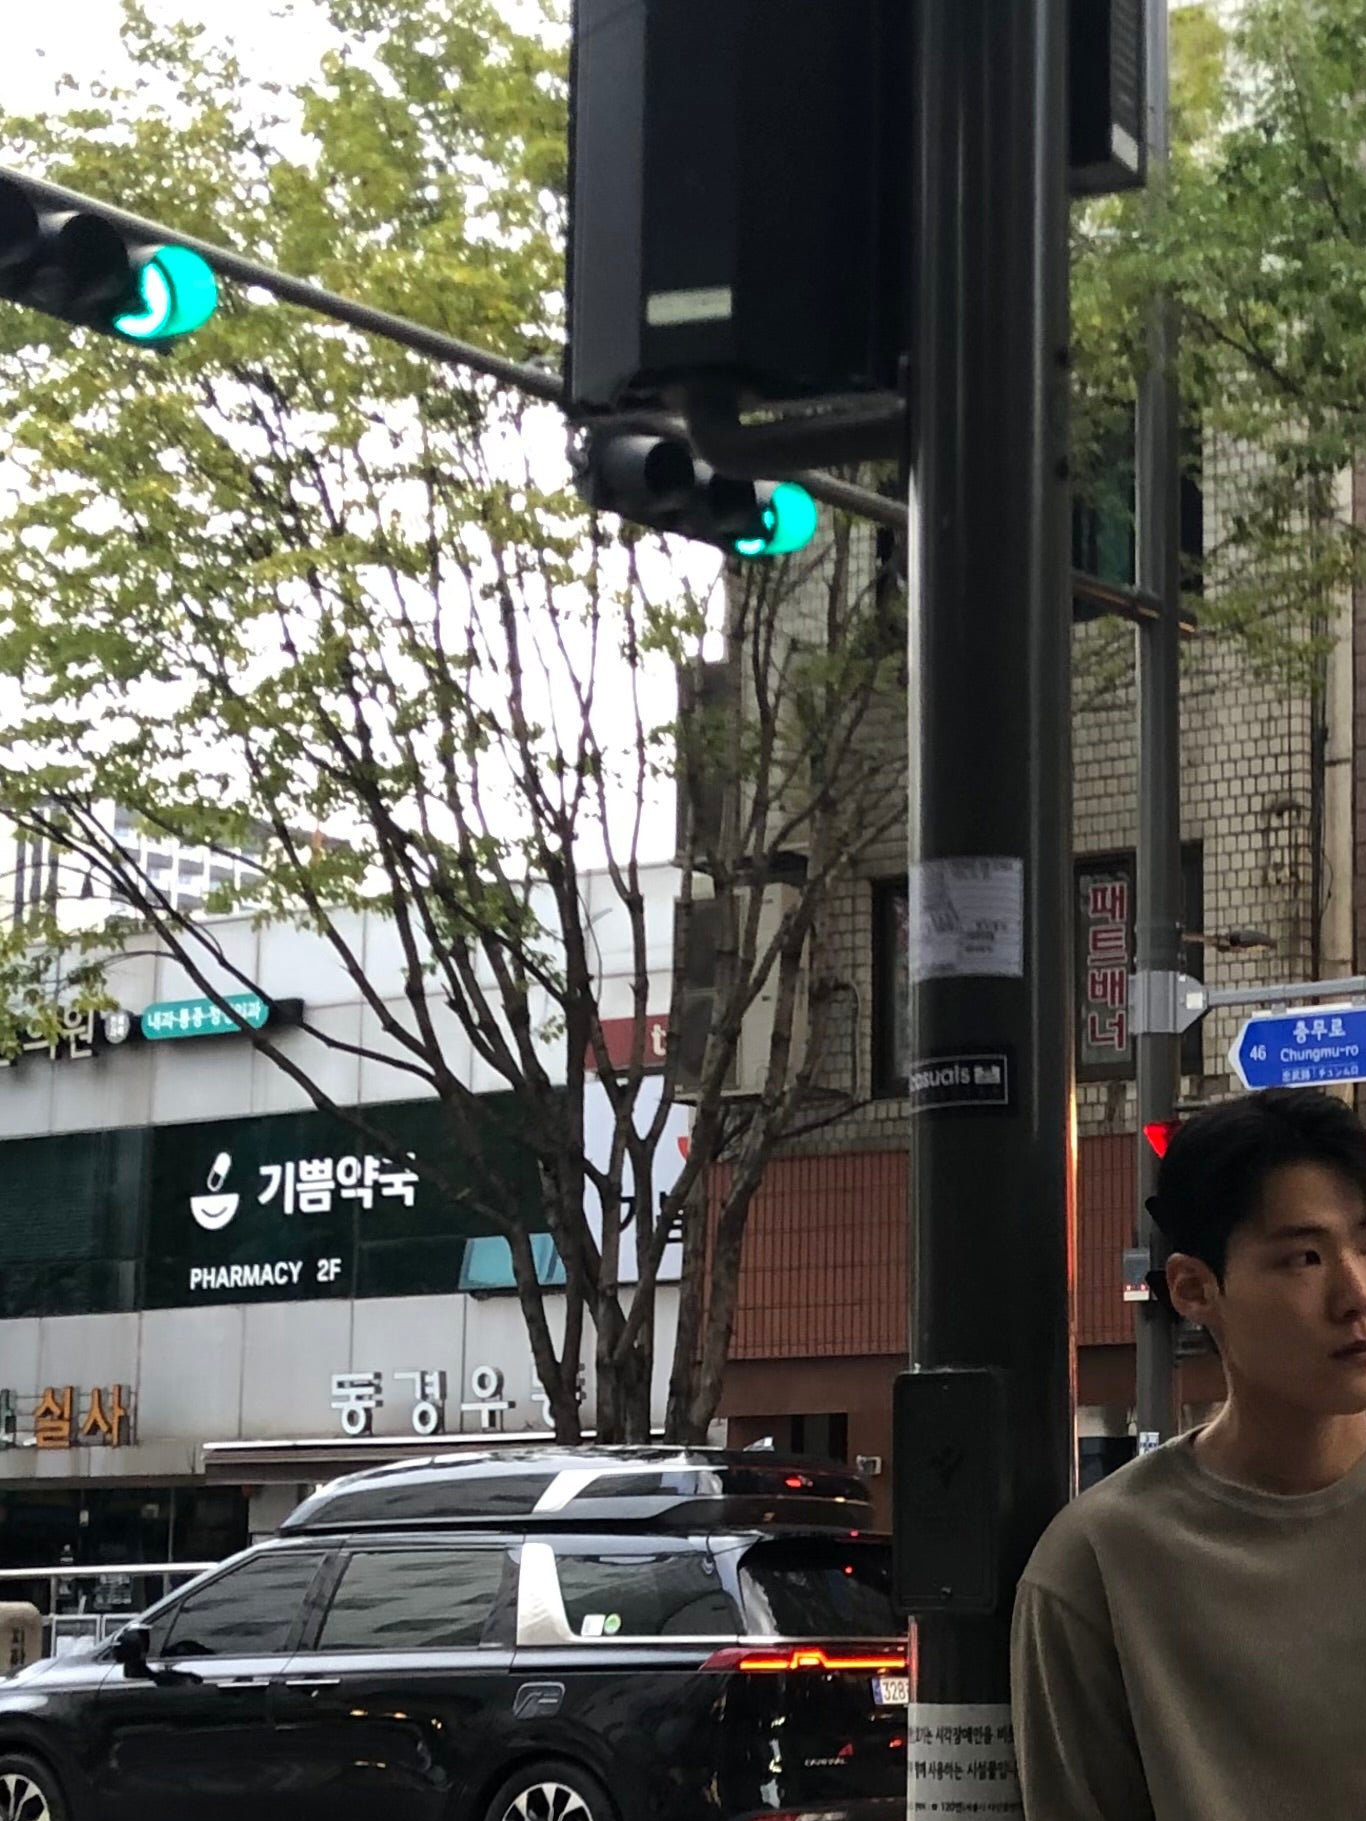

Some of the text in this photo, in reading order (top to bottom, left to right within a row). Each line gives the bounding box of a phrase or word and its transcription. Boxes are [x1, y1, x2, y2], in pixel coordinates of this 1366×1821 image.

[1089, 883, 1125, 1050] 패트배너
[1293, 1018, 1346, 1044] 충무로
[1249, 1045, 1267, 1061] 46
[1280, 1045, 1359, 1063] Chungmu-ro
[257, 1152, 420, 1215] 기쁨약국
[190, 1258, 341, 1290] PHARMACY 2F
[883, 1681, 909, 1701] 328
